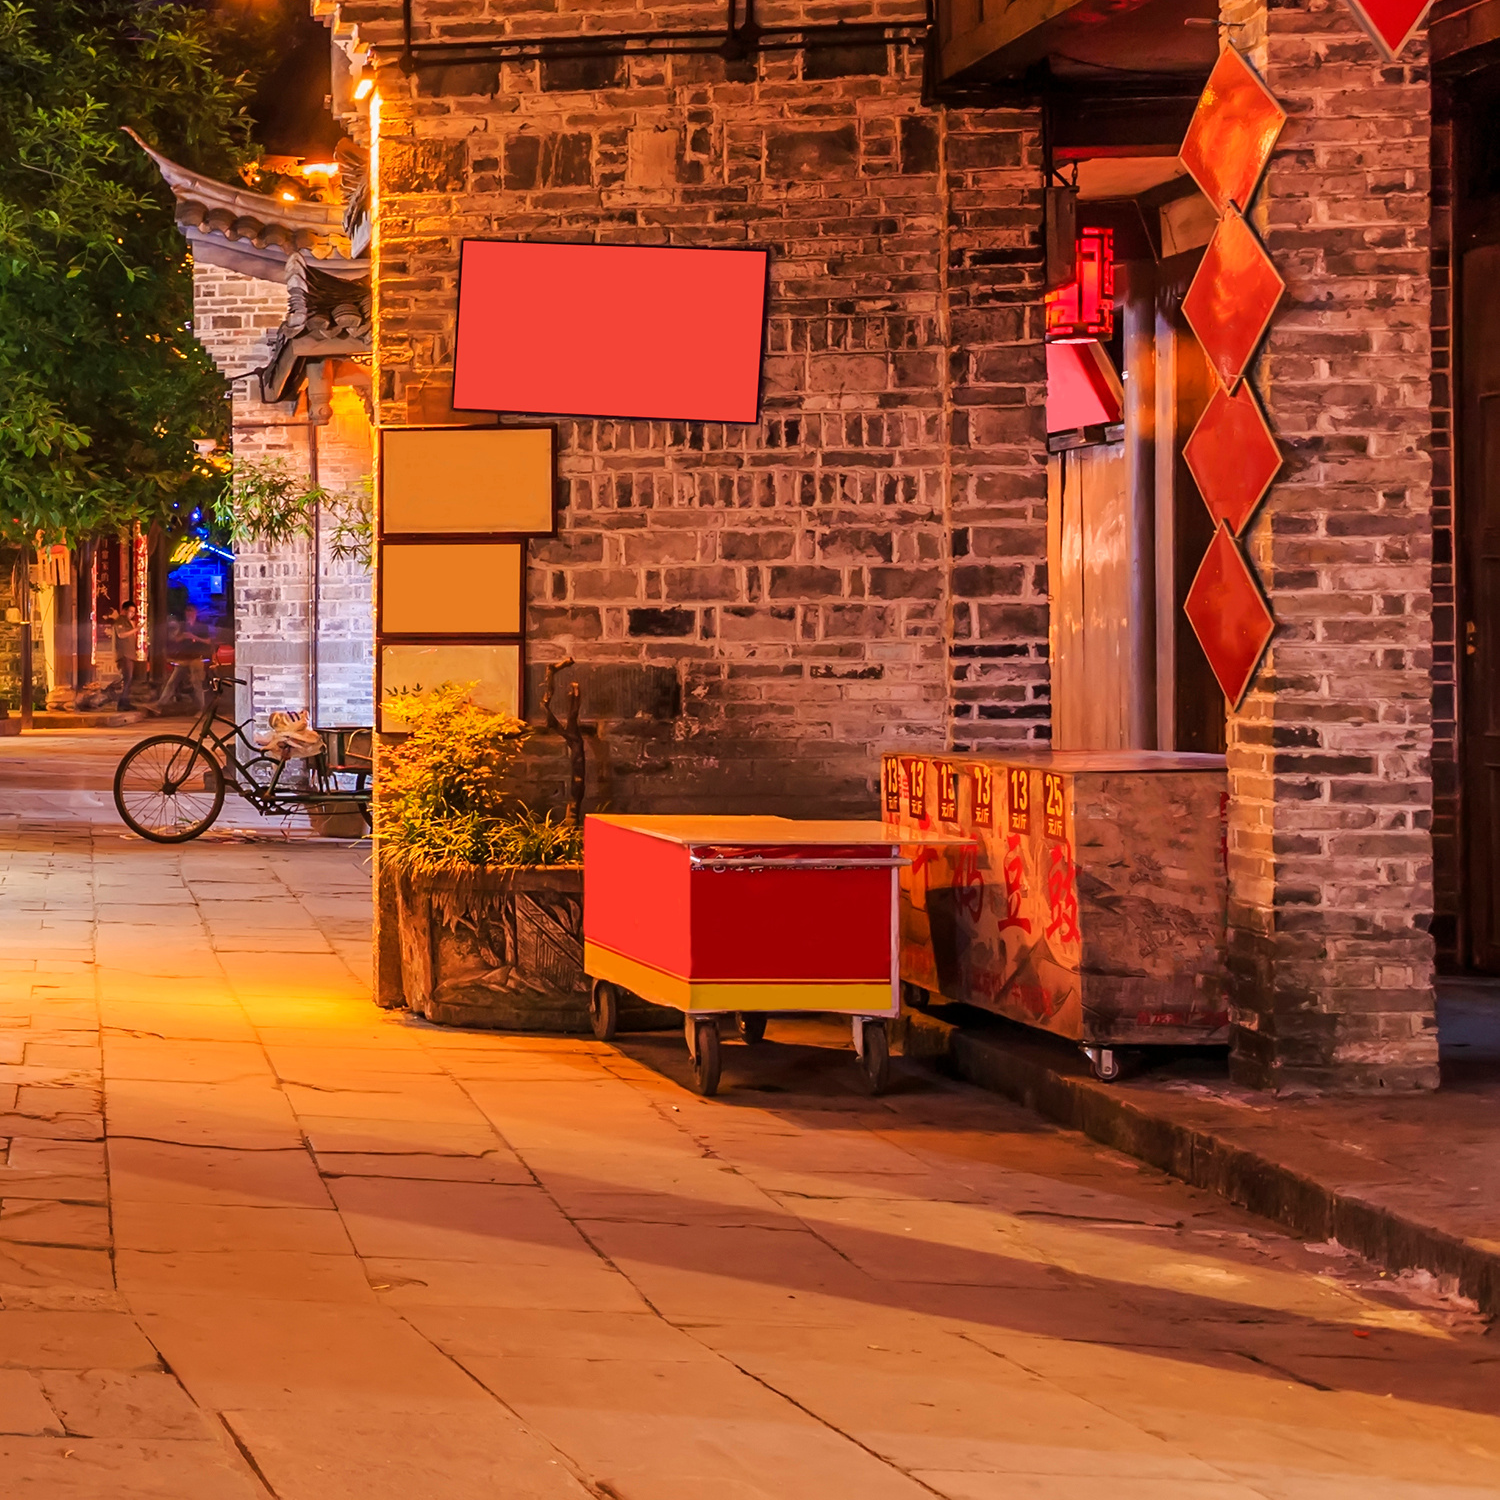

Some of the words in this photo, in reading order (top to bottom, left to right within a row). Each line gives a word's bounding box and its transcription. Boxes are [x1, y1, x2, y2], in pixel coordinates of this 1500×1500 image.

[887, 758, 898, 793] 13
[910, 761, 924, 798] 13
[974, 766, 991, 805] 13
[1011, 770, 1028, 810] 13
[1045, 773, 1064, 817] 25
[975, 807, 989, 823] 元/斤
[1012, 813, 1027, 830] 元/斤
[1047, 818, 1063, 837] 元/斤
